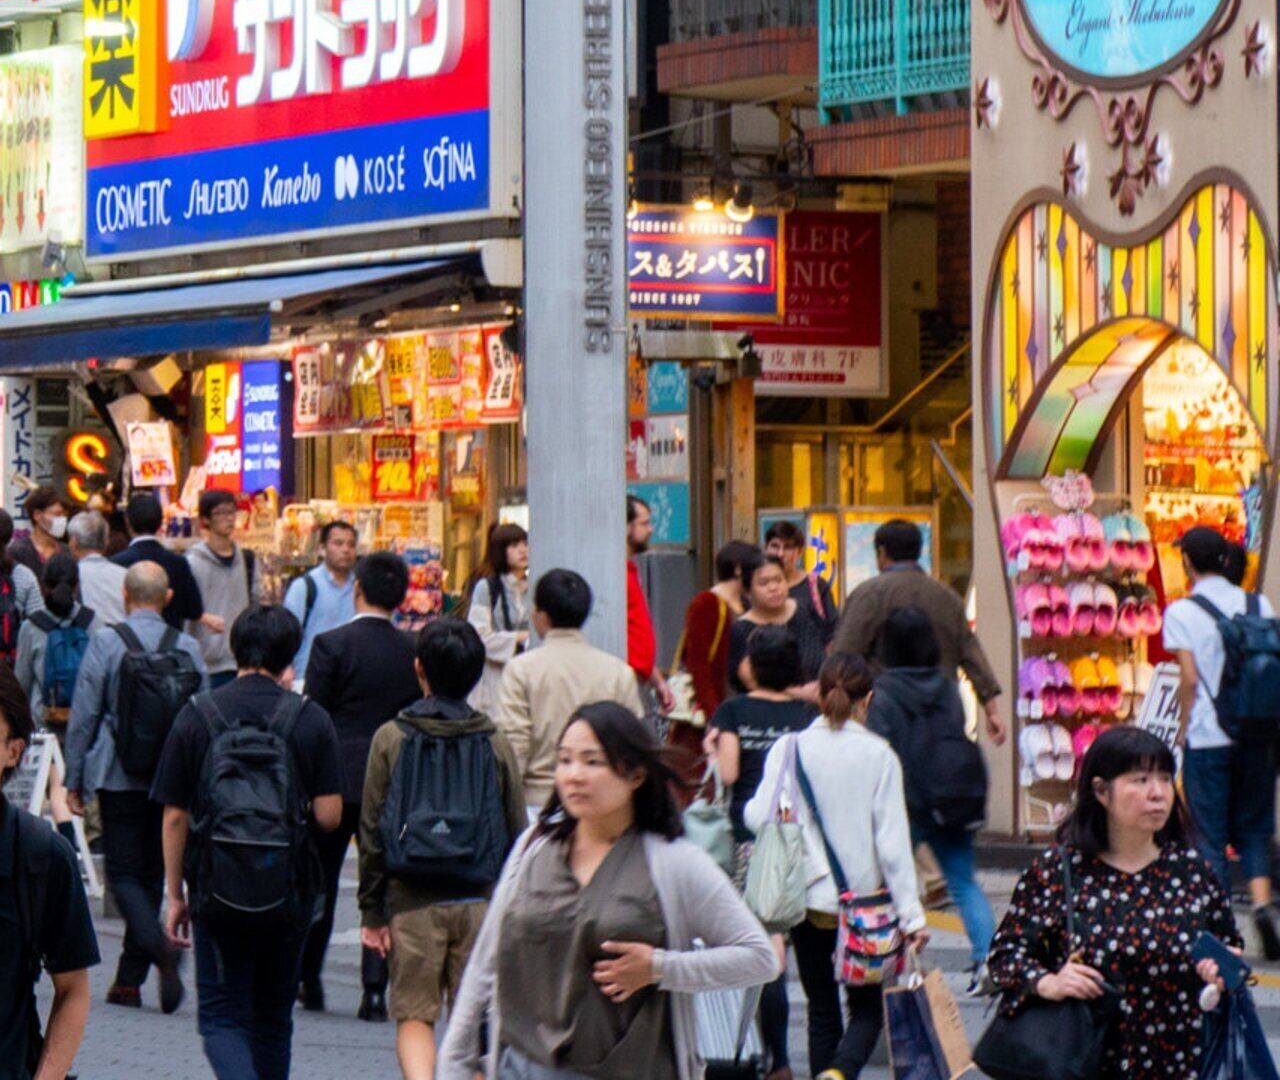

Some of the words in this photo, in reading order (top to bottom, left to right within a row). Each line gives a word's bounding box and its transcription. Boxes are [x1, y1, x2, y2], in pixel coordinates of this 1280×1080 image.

[170, 76, 229, 118] SUNDRUG
[95, 178, 172, 235] COSMETIC
[183, 176, 249, 220] SHISEIDO
[260, 166, 322, 209] Kanebo
[423, 137, 476, 191] SOFINA
